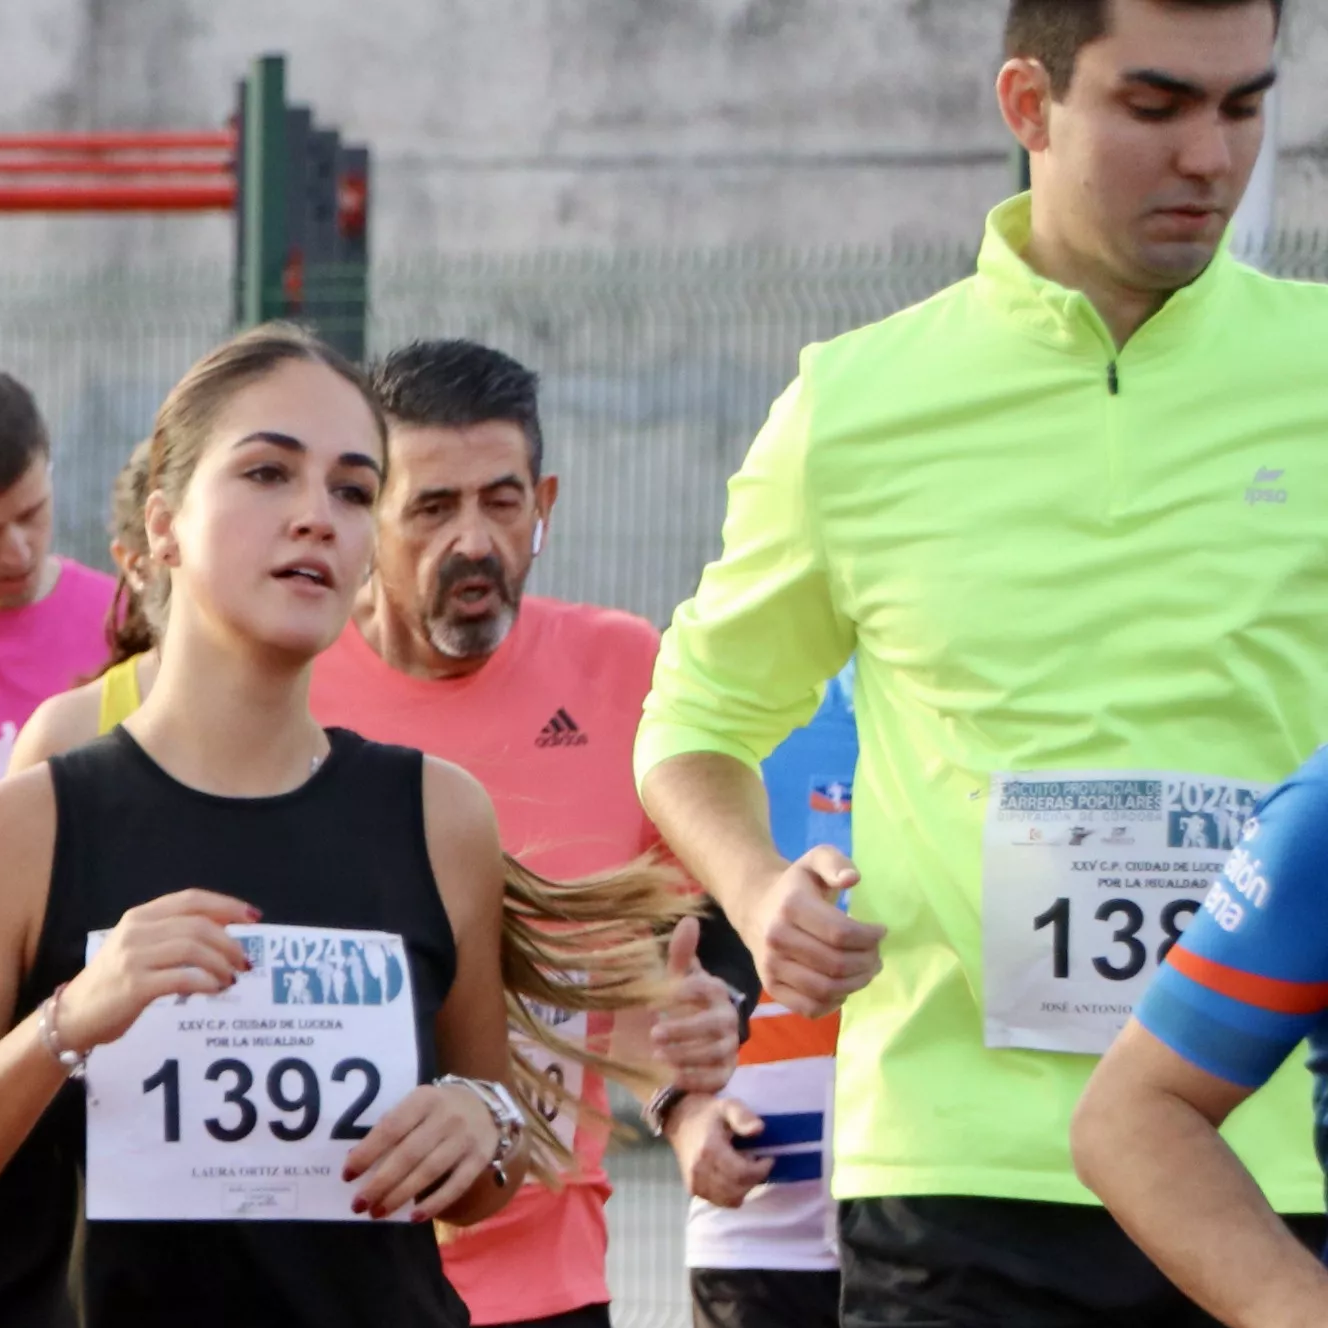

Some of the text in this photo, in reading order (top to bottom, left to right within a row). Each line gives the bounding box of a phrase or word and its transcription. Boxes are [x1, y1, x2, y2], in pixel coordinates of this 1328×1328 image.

[533, 731, 589, 749] adidas
[1063, 781, 1140, 796] PROVINCIAL
[1145, 781, 1162, 796] DE
[1164, 780, 1239, 812] 2024
[999, 795, 1162, 810] CARRERAS POPULARES
[1070, 860, 1223, 873] XXV C.P. CIUDAD DE LUCE
[1097, 877, 1208, 889] POR LA IGUALDAD
[1033, 896, 1202, 981] 138
[268, 935, 347, 967] 2024
[1074, 1003, 1133, 1015] ANTONIO
[178, 1019, 343, 1031] XXV C.P. CIUDAD DE LUCENA
[206, 1036, 230, 1048] POR
[232, 1036, 249, 1047] LA
[141, 1056, 382, 1142] 1392
[191, 1166, 236, 1178] LAURA
[239, 1166, 280, 1177] ORTIZ
